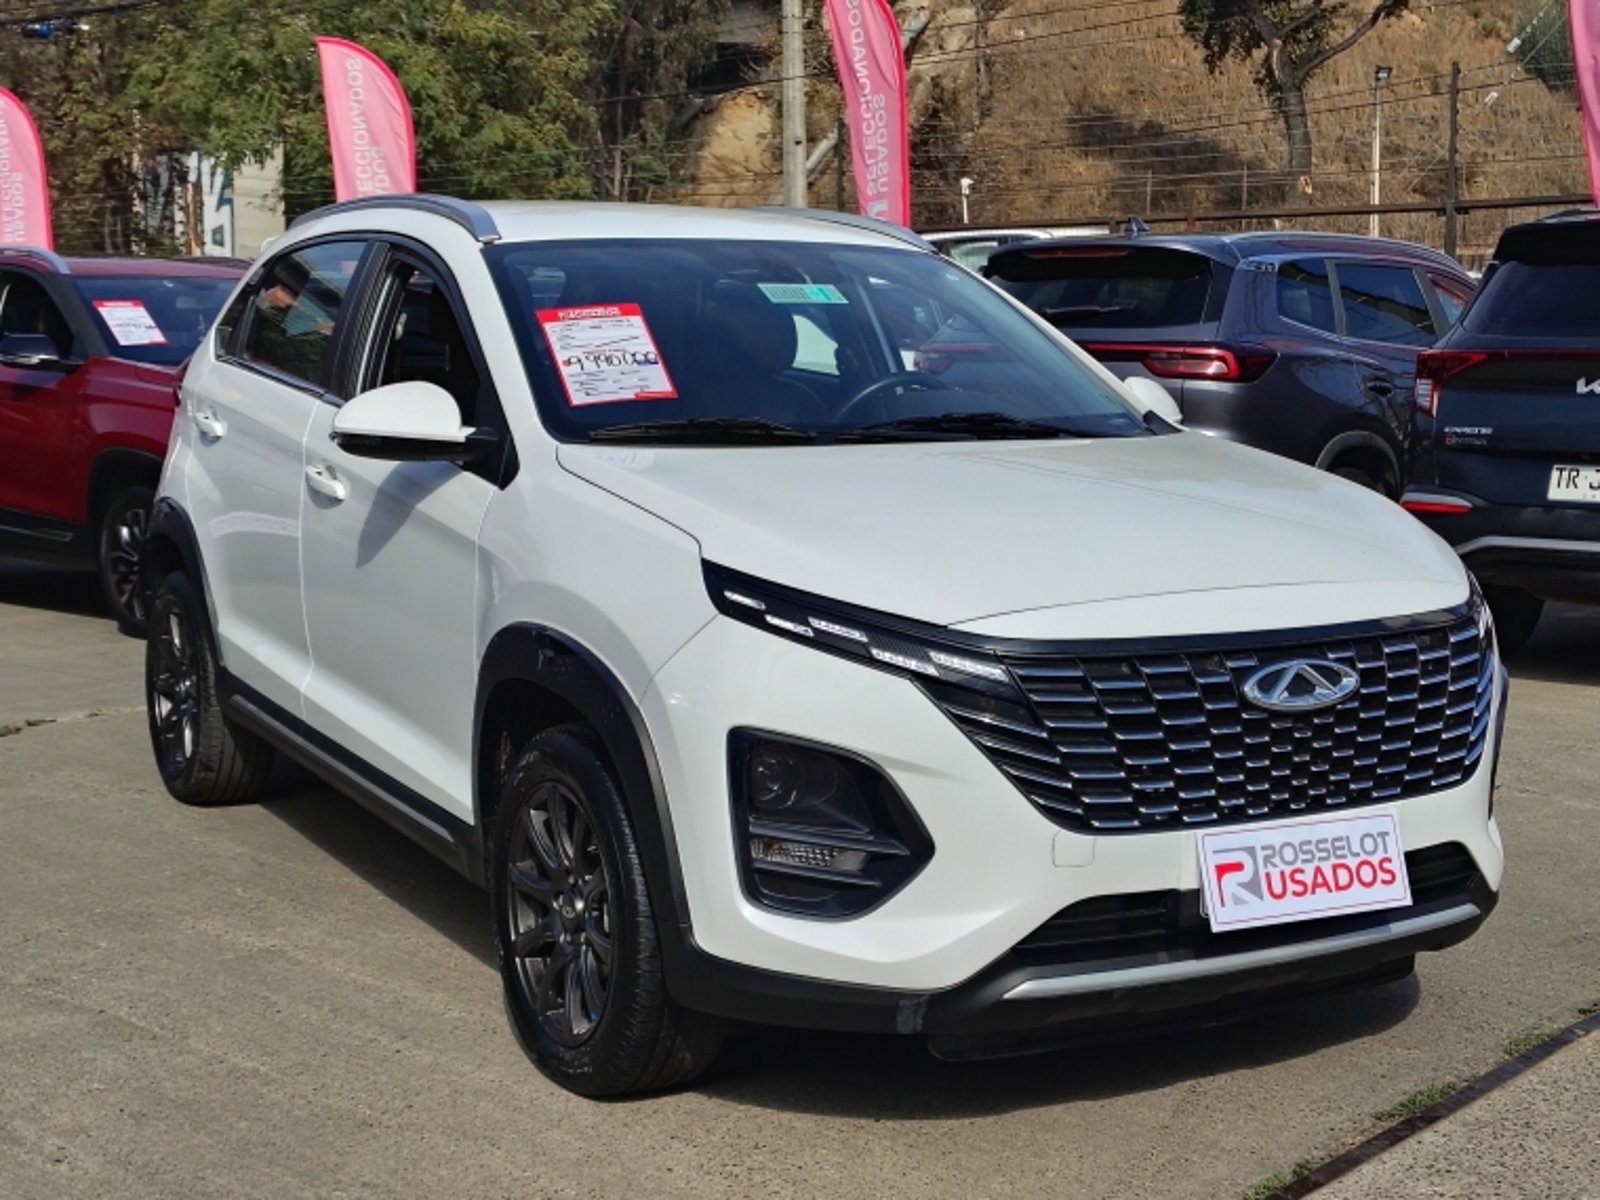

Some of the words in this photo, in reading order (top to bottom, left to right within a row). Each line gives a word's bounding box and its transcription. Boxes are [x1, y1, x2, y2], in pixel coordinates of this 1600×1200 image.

[1555, 467, 1581, 489] TR
[1261, 831, 1390, 868] ROSSELOT
[1265, 856, 1396, 900] USADOS
